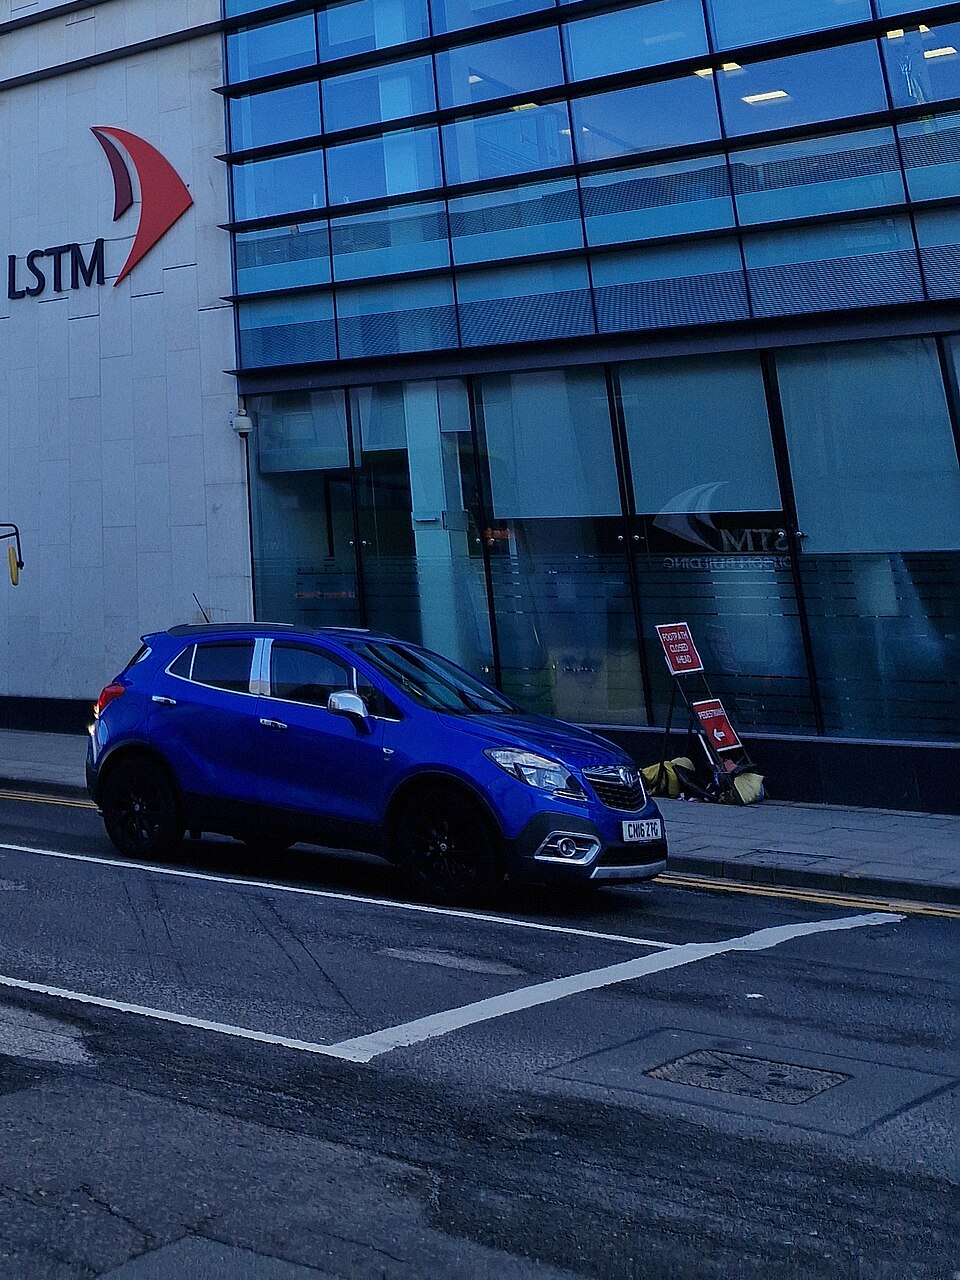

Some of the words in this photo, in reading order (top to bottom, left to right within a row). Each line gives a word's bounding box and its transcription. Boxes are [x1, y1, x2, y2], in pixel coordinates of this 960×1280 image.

[7, 238, 105, 300] LSTM
[662, 631, 689, 642] FOOTPATH
[669, 643, 689, 653] CLOSED
[675, 655, 692, 664] AHEAD
